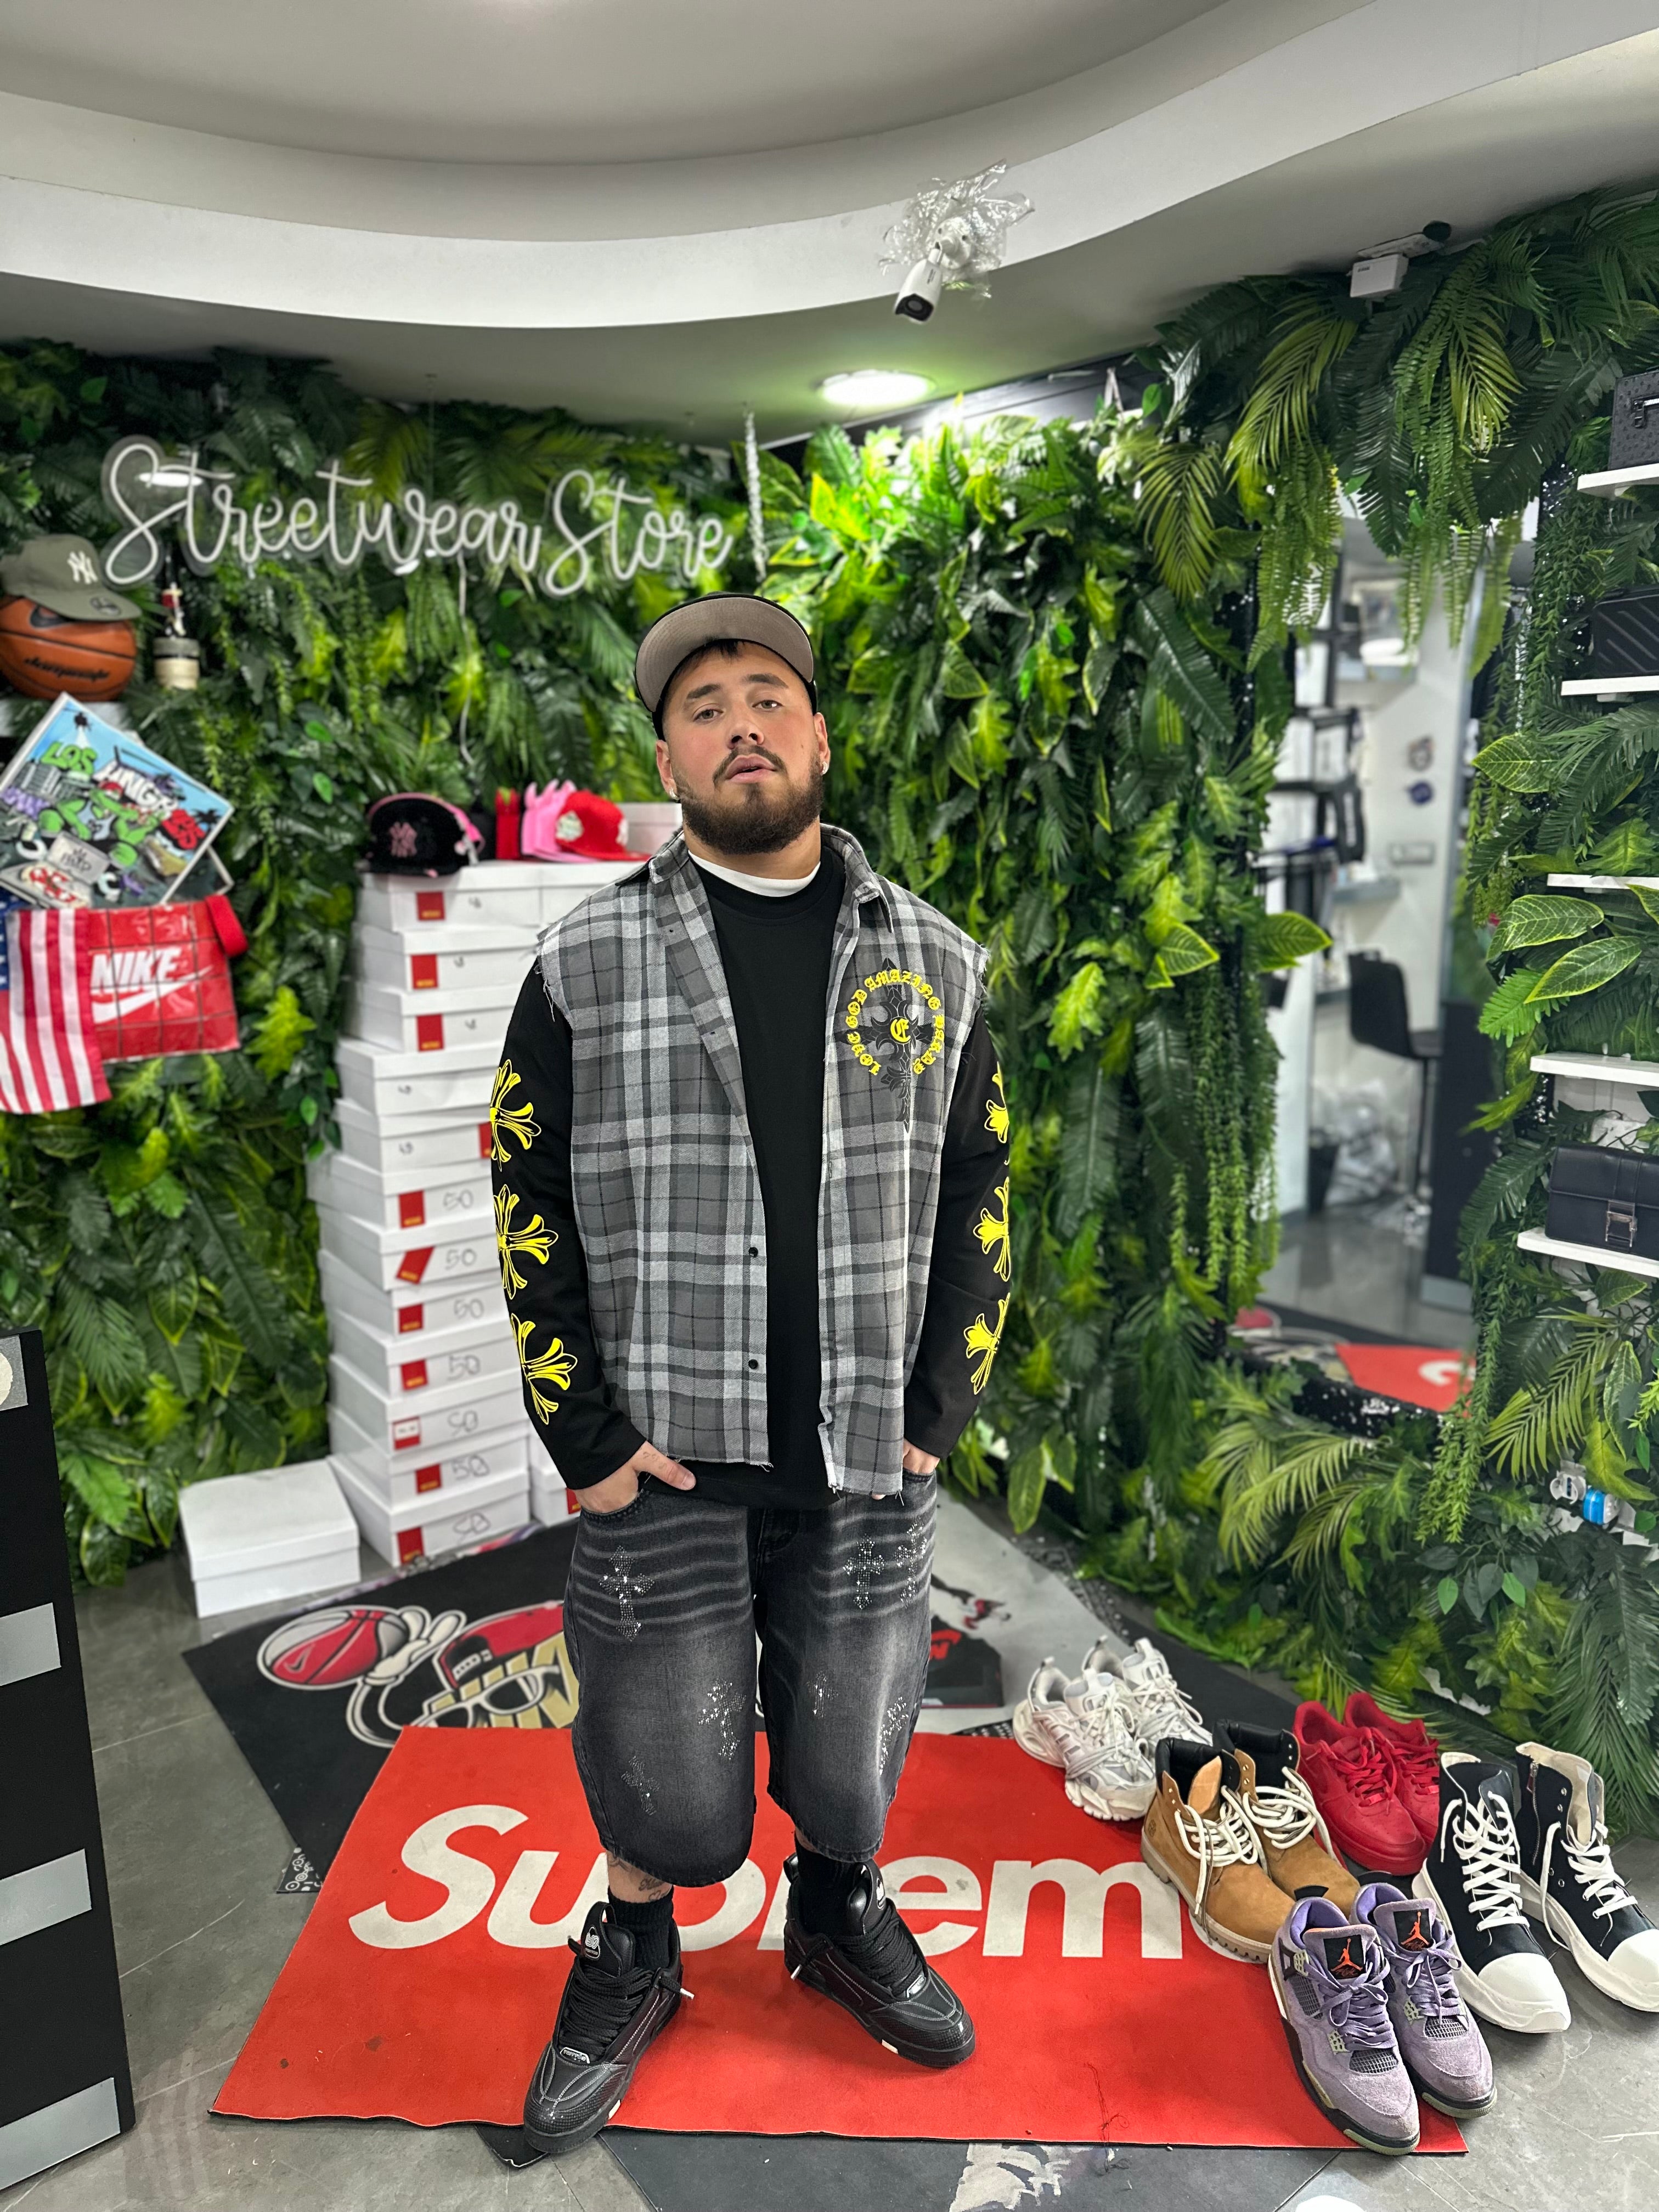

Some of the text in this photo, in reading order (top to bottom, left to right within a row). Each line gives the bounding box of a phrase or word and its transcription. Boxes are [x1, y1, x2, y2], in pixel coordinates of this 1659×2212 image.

[106, 442, 733, 596] Streetwear Store
[67, 551, 98, 584] NY
[41, 742, 98, 776] LOS
[92, 947, 180, 994] NIKE
[445, 1248, 477, 1271] 50
[454, 1298, 484, 1319] 50
[448, 1355, 481, 1381] 50
[452, 1455, 490, 1480] 50
[349, 1805, 1267, 1964] Suem
